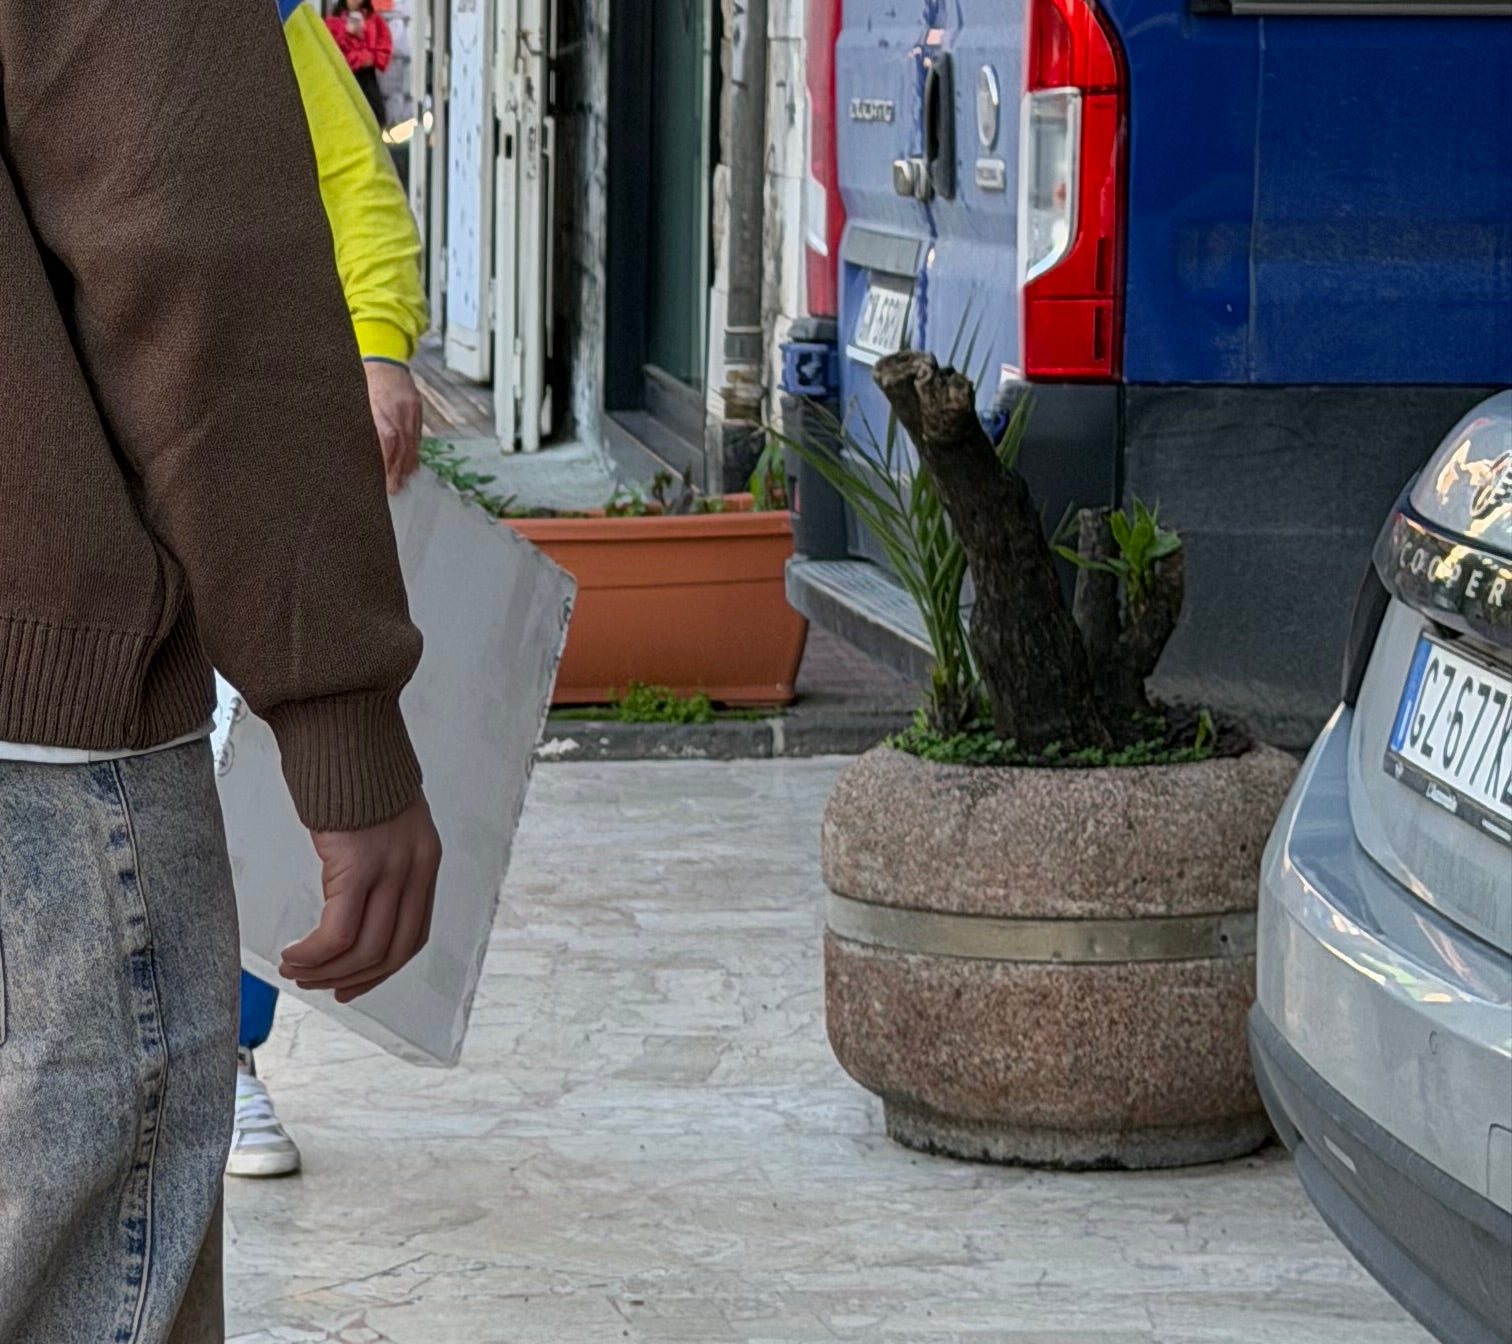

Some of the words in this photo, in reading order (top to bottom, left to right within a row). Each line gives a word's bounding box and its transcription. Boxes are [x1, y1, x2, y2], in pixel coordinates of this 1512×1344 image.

[1398, 541, 1507, 608] COOPER
[1409, 656, 1457, 759] GZ
[1442, 675, 1512, 806] 677K
